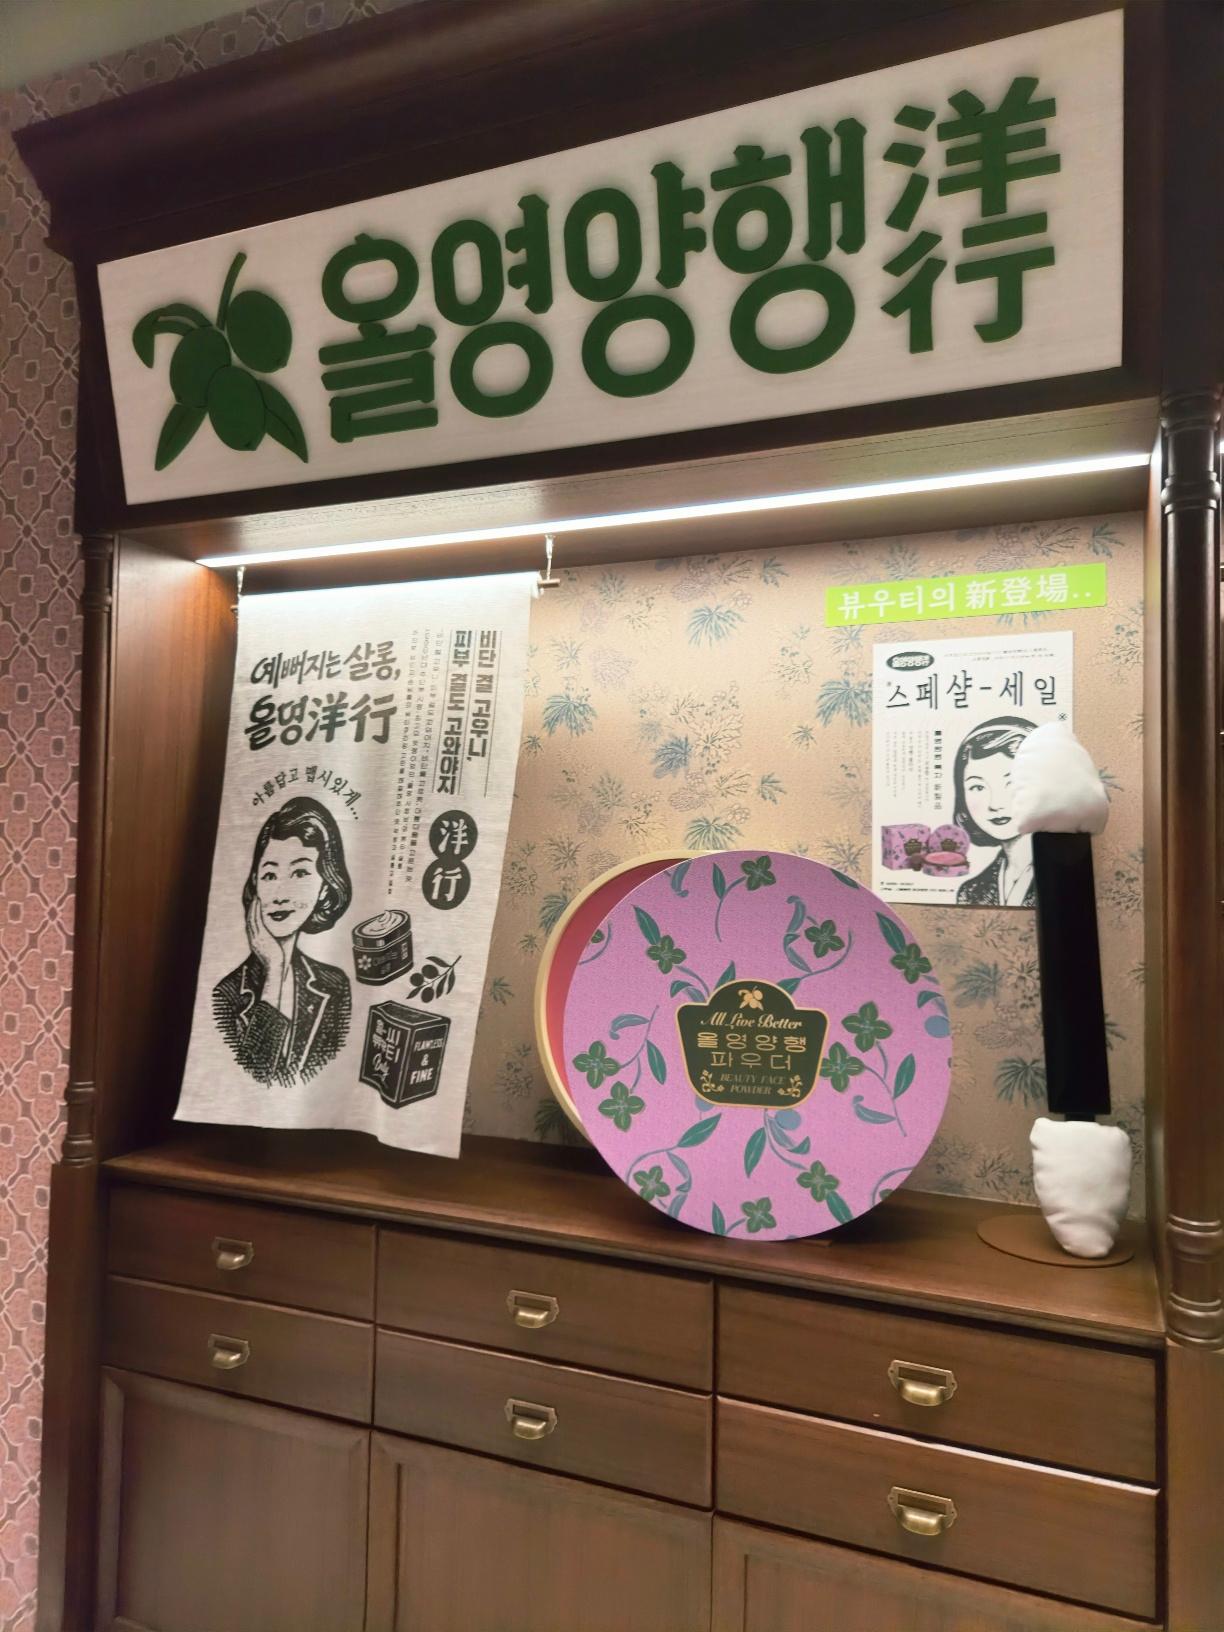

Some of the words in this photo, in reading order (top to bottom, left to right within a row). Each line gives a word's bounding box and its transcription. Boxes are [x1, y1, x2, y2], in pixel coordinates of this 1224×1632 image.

[881, 76, 1061, 353] 洋行
[319, 118, 867, 443] 올영양행
[838, 583, 955, 620] 뷰우티의
[250, 651, 342, 689] 예뻐지는
[343, 640, 400, 682] 살롱,
[452, 630, 472, 668] 피부
[252, 768, 299, 806] 아름답고
[431, 818, 469, 903] 洋行
[700, 1012, 727, 1026] All
[757, 1013, 803, 1030] Better
[409, 1067, 434, 1085] FINE
[710, 1052, 792, 1071] 파우더
[730, 1085, 772, 1096] POWDER
